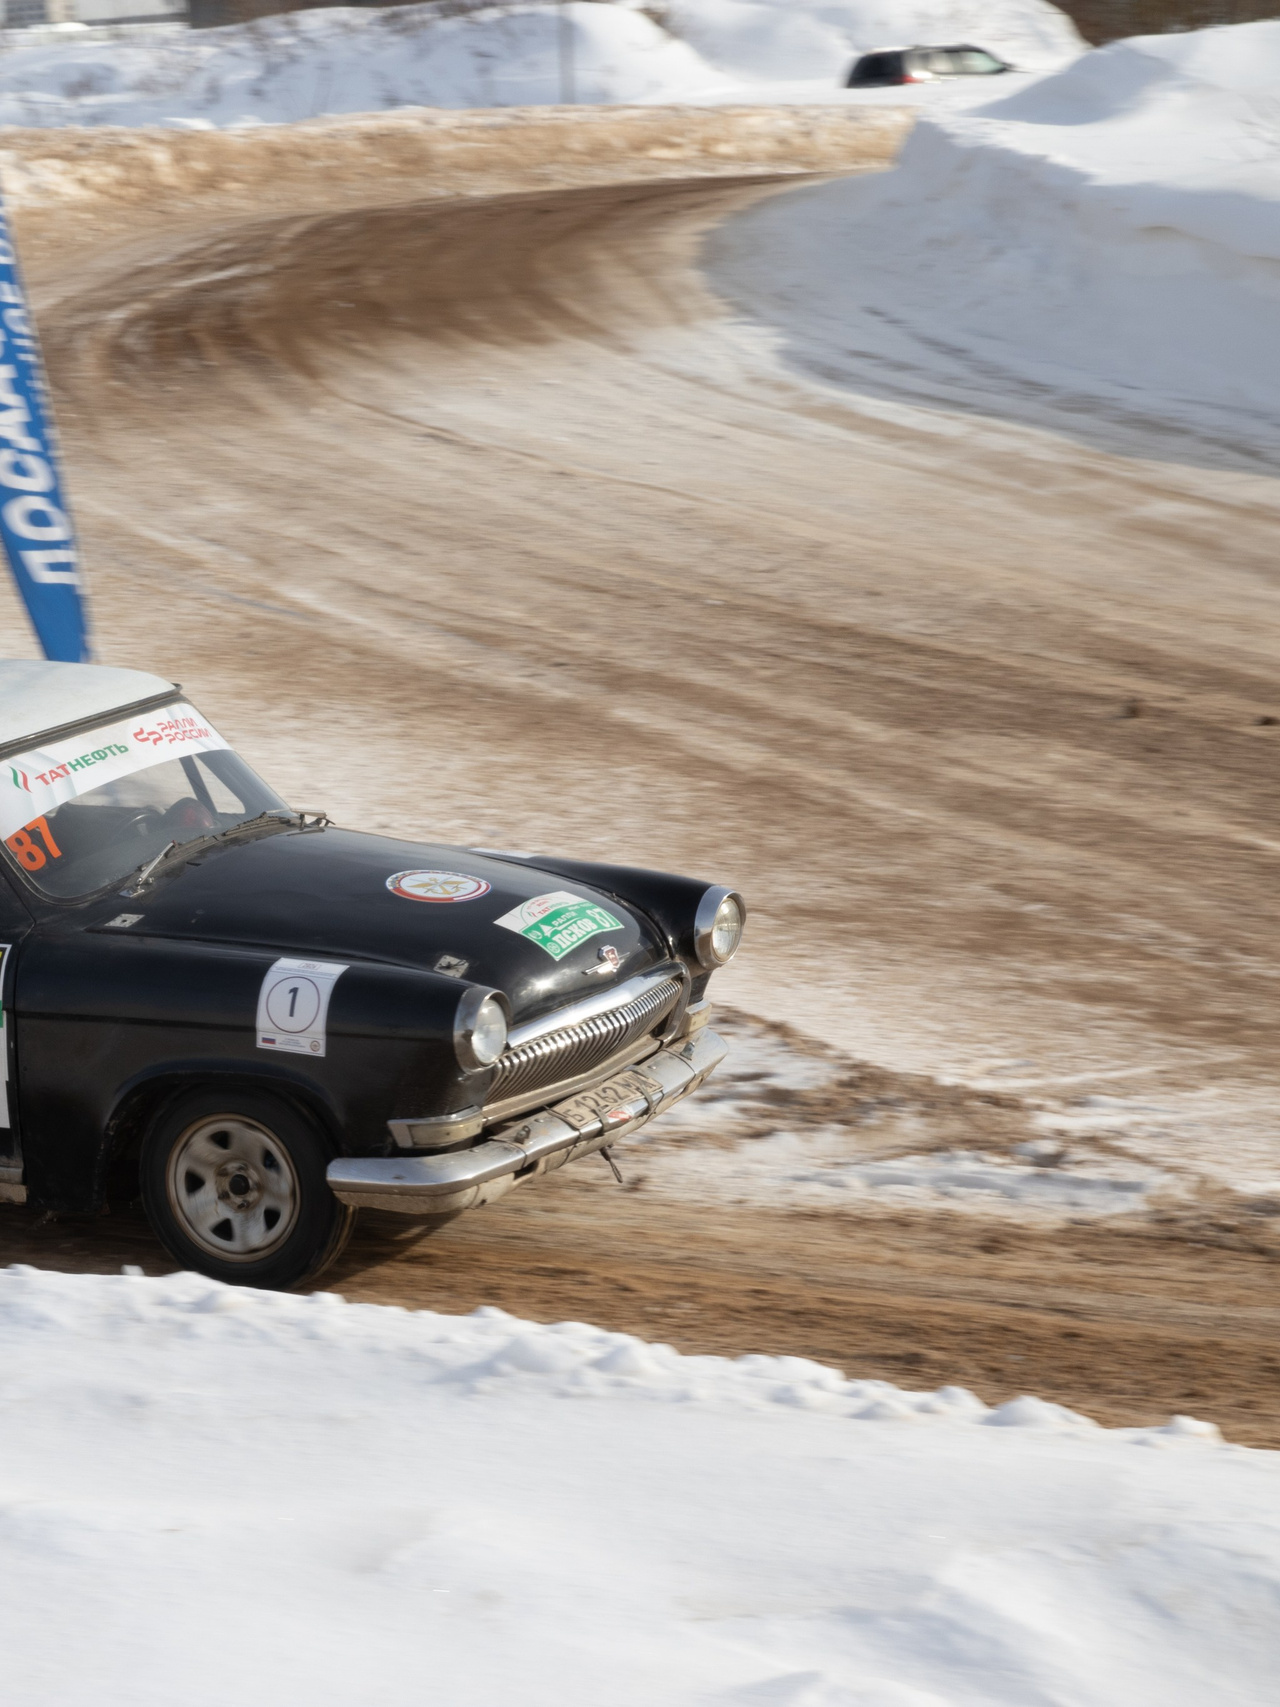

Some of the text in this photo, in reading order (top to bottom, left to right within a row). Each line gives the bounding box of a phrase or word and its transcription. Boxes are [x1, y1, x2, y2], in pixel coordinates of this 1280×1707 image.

[156, 717, 198, 732] РАЛЛИ
[164, 728, 211, 744] РОССИИ
[34, 743, 129, 786] ТАТНЕФТЬ
[5, 815, 62, 871] 87
[552, 918, 598, 948] ПСКОВ
[586, 908, 615, 928] 87
[288, 987, 299, 1017] 1
